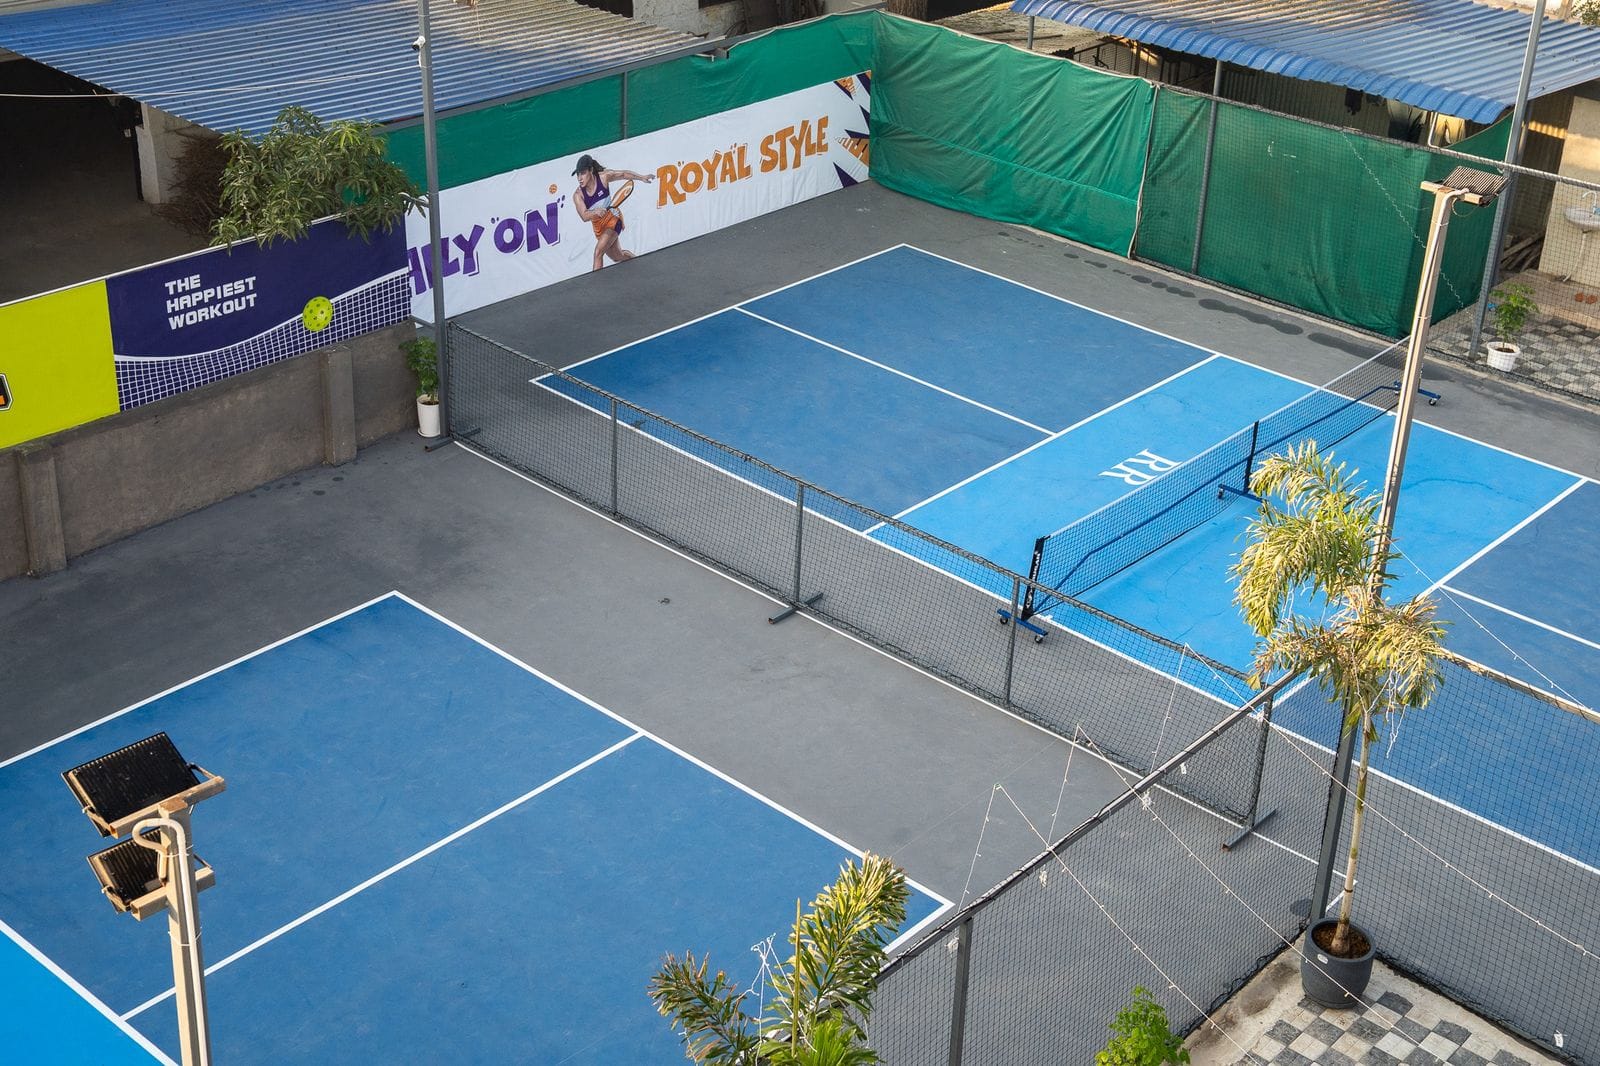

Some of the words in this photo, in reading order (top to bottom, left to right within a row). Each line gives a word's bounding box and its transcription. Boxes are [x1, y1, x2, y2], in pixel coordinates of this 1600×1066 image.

[656, 144, 752, 208] ROYAL
[759, 115, 829, 174] STYLE
[493, 202, 560, 254] ON
[165, 274, 201, 295] THE
[166, 276, 256, 313] HAPPIEST
[168, 293, 257, 330] WORKOUT
[1098, 448, 1184, 485] RR
